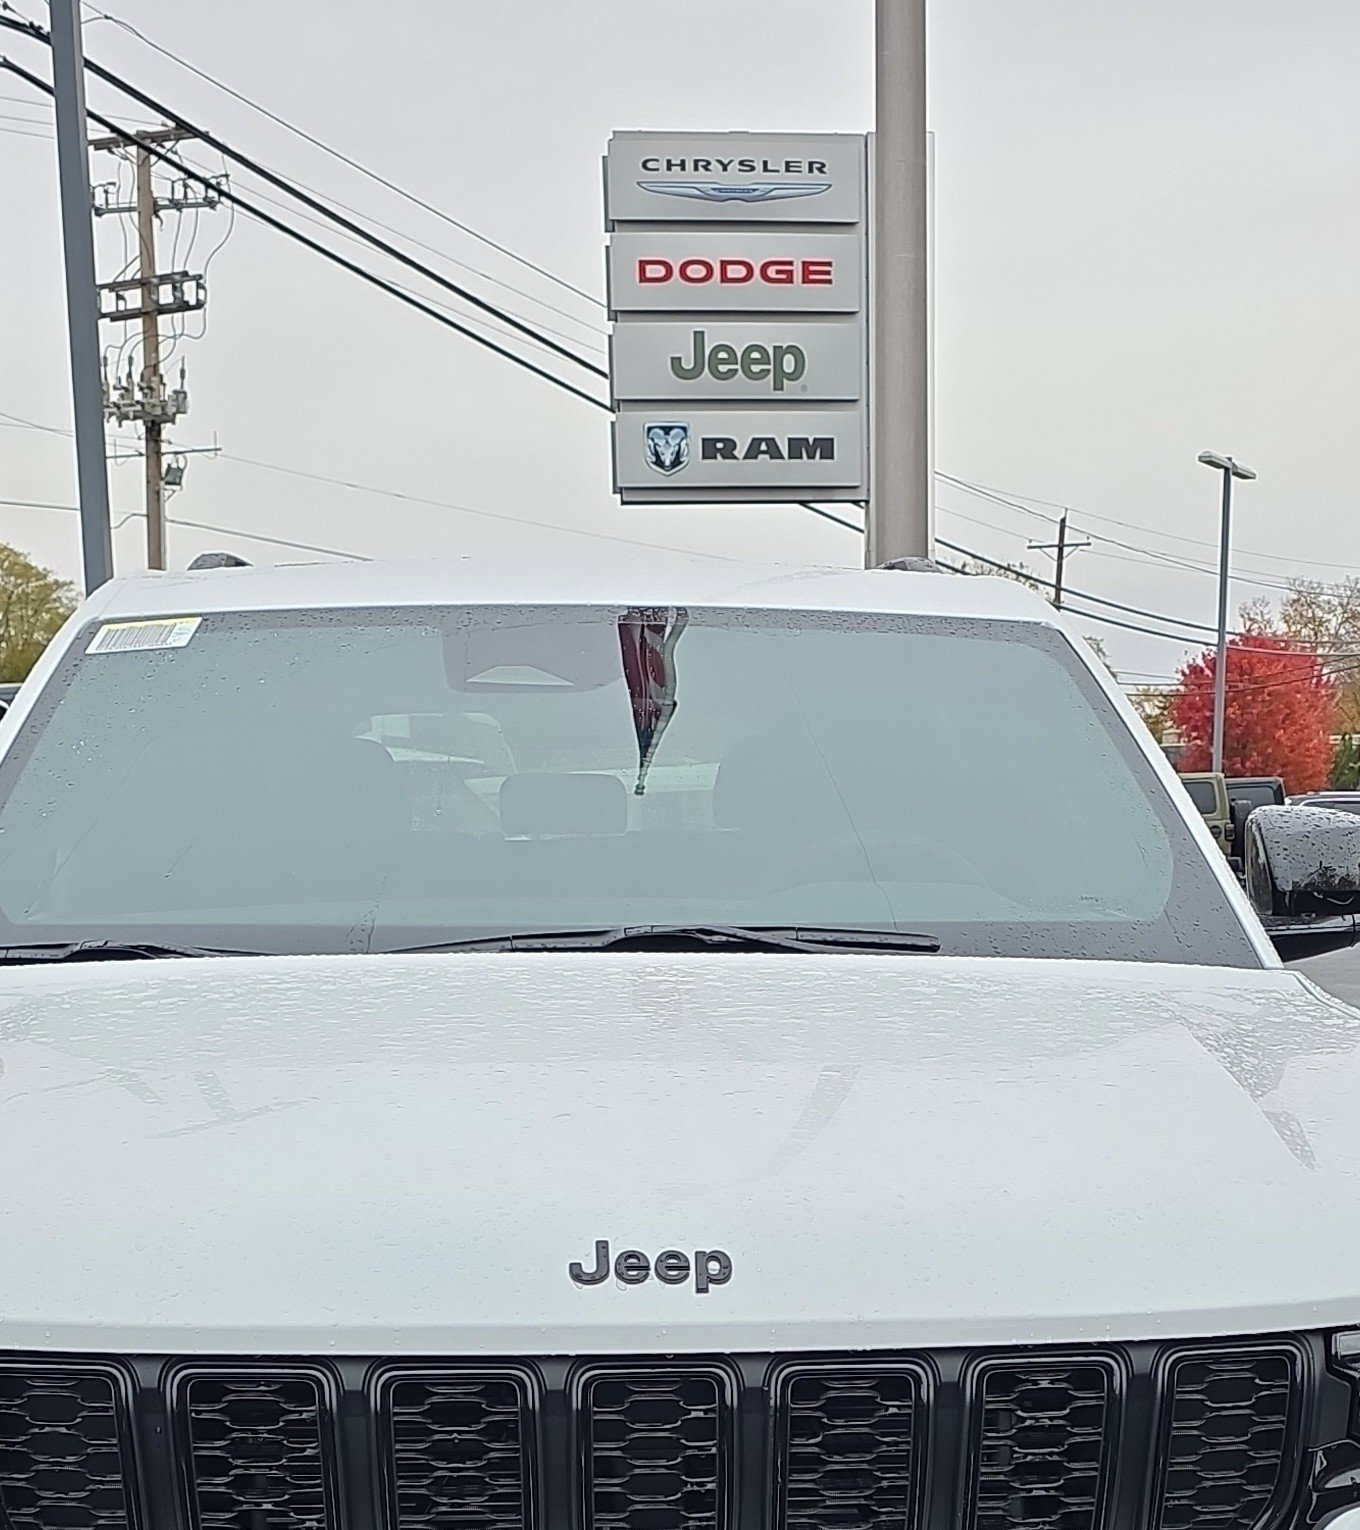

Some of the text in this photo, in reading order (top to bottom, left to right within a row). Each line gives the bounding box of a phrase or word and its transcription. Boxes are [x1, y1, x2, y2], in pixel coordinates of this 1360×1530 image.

[640, 157, 828, 175] CHRYSLER
[637, 258, 834, 286] DODGE
[670, 330, 806, 391] Jeep
[701, 436, 836, 461] RAM
[569, 1239, 733, 1294] Jeep
